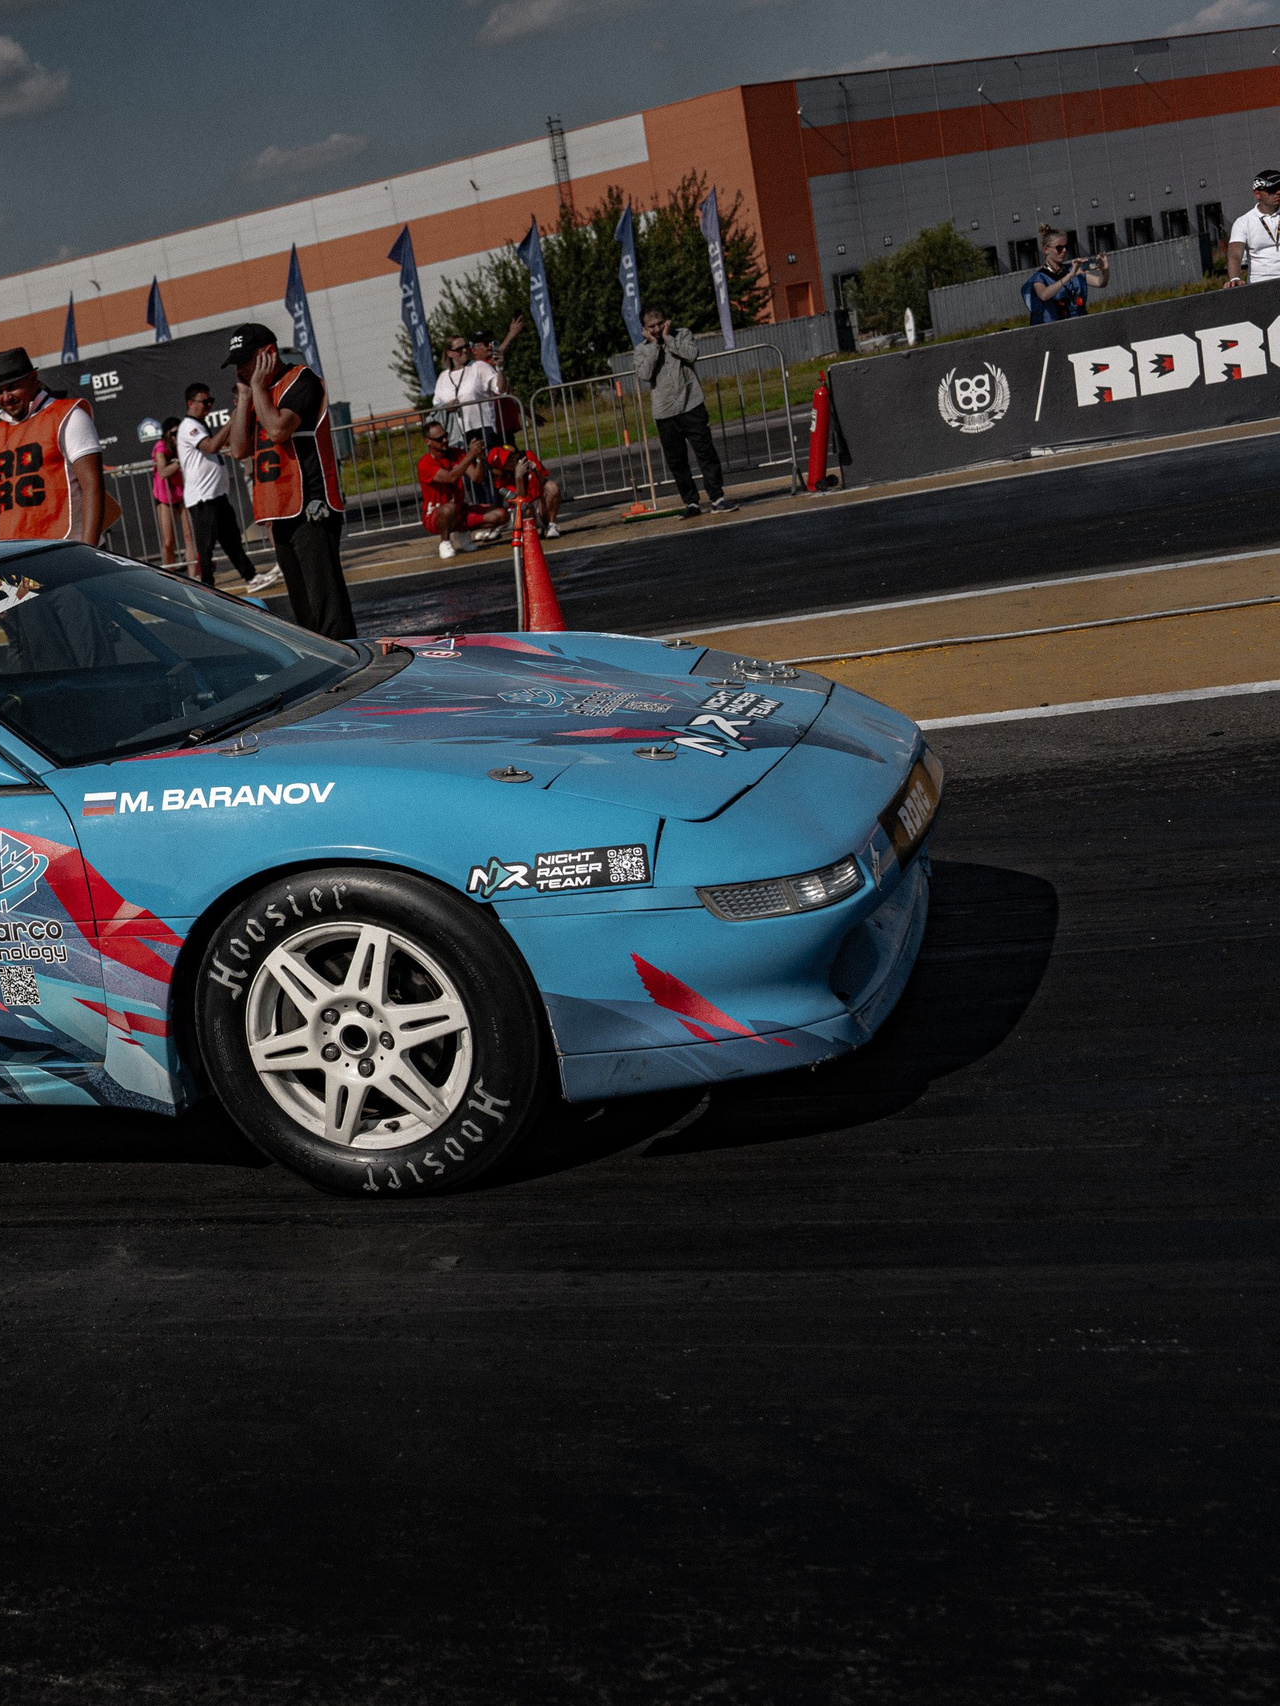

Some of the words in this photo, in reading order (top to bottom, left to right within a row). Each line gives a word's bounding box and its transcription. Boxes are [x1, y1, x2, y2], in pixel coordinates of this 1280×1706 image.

[1067, 316, 1280, 407] RDR
[92, 370, 119, 389] ВТБ
[745, 698, 782, 719] TEAM
[119, 791, 154, 814] M.
[162, 782, 336, 811] BARANOV
[537, 851, 595, 866] NIGHT
[536, 862, 602, 878] RACER
[536, 875, 592, 890] TEAM
[209, 883, 349, 1001] Hoosier
